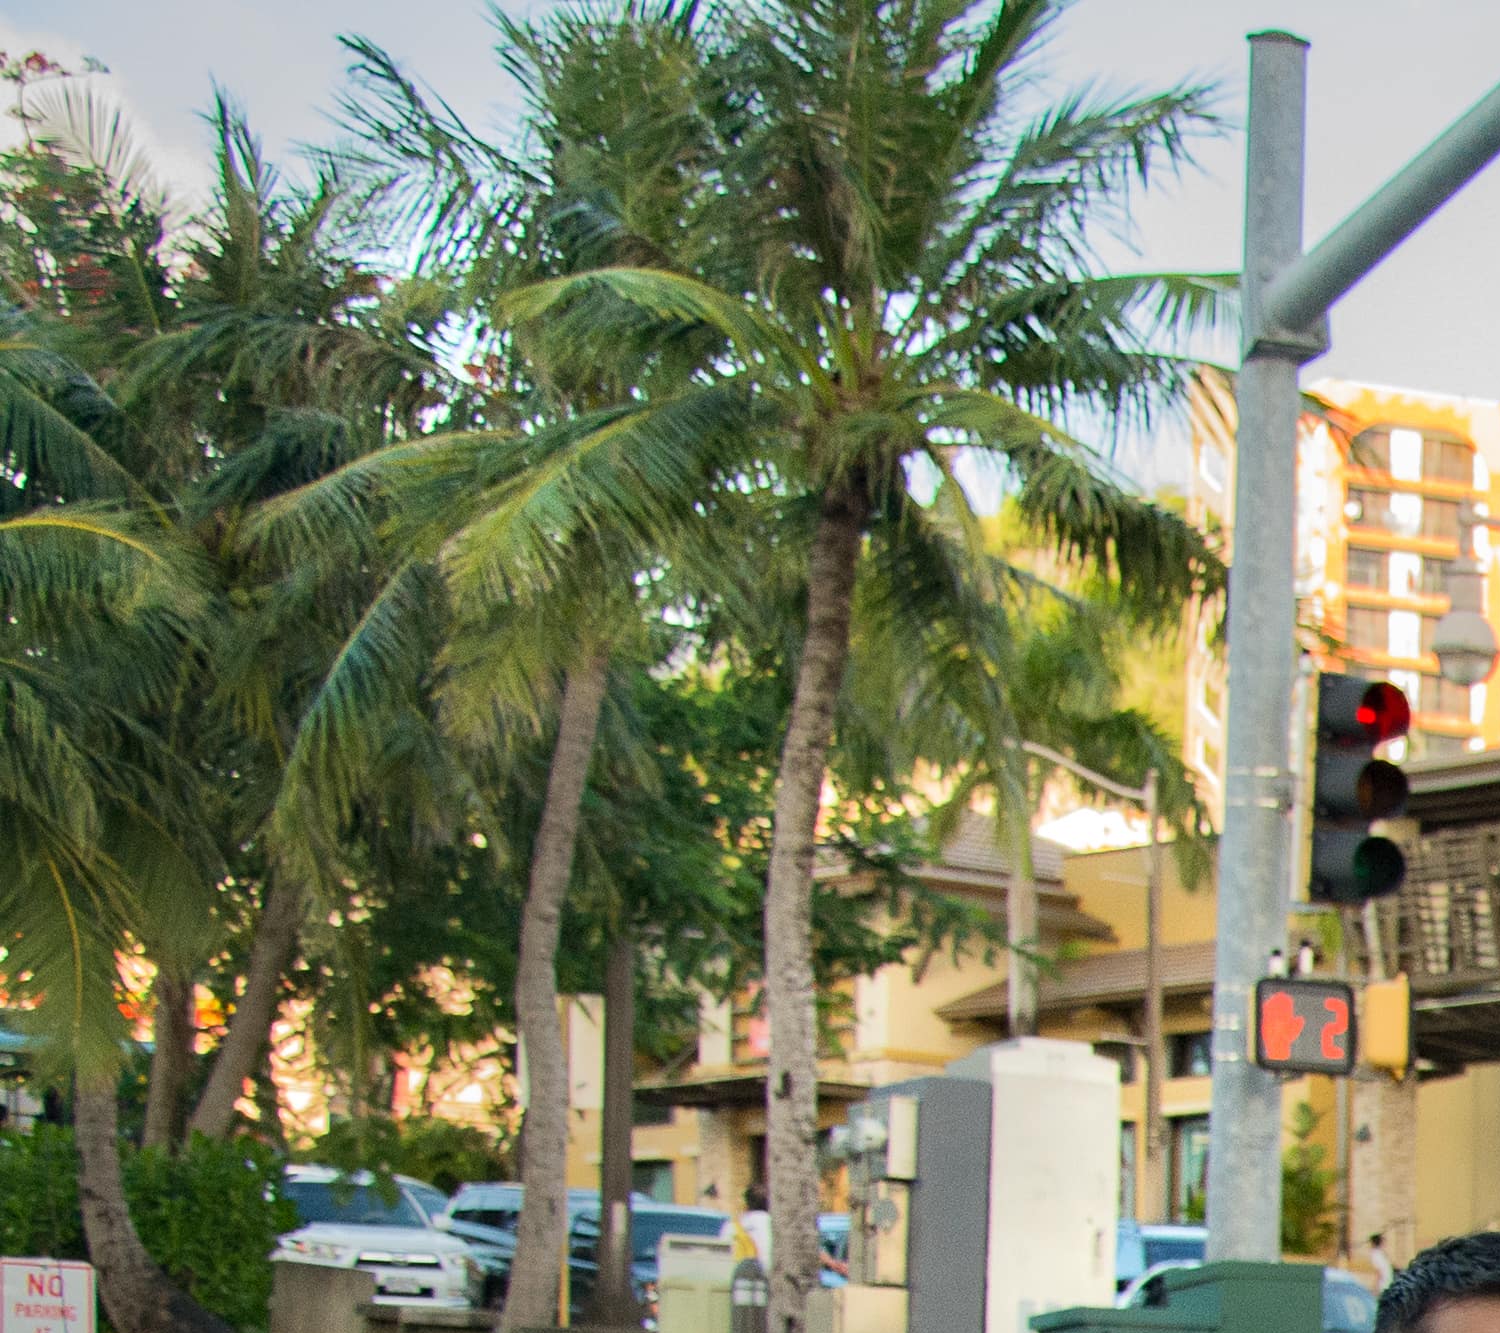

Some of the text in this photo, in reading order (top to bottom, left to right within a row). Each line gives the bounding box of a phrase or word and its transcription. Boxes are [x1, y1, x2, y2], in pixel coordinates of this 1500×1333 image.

[1320, 996, 1350, 1060] 2
[27, 1272, 64, 1298] NO
[14, 1303, 78, 1322] PARKING
